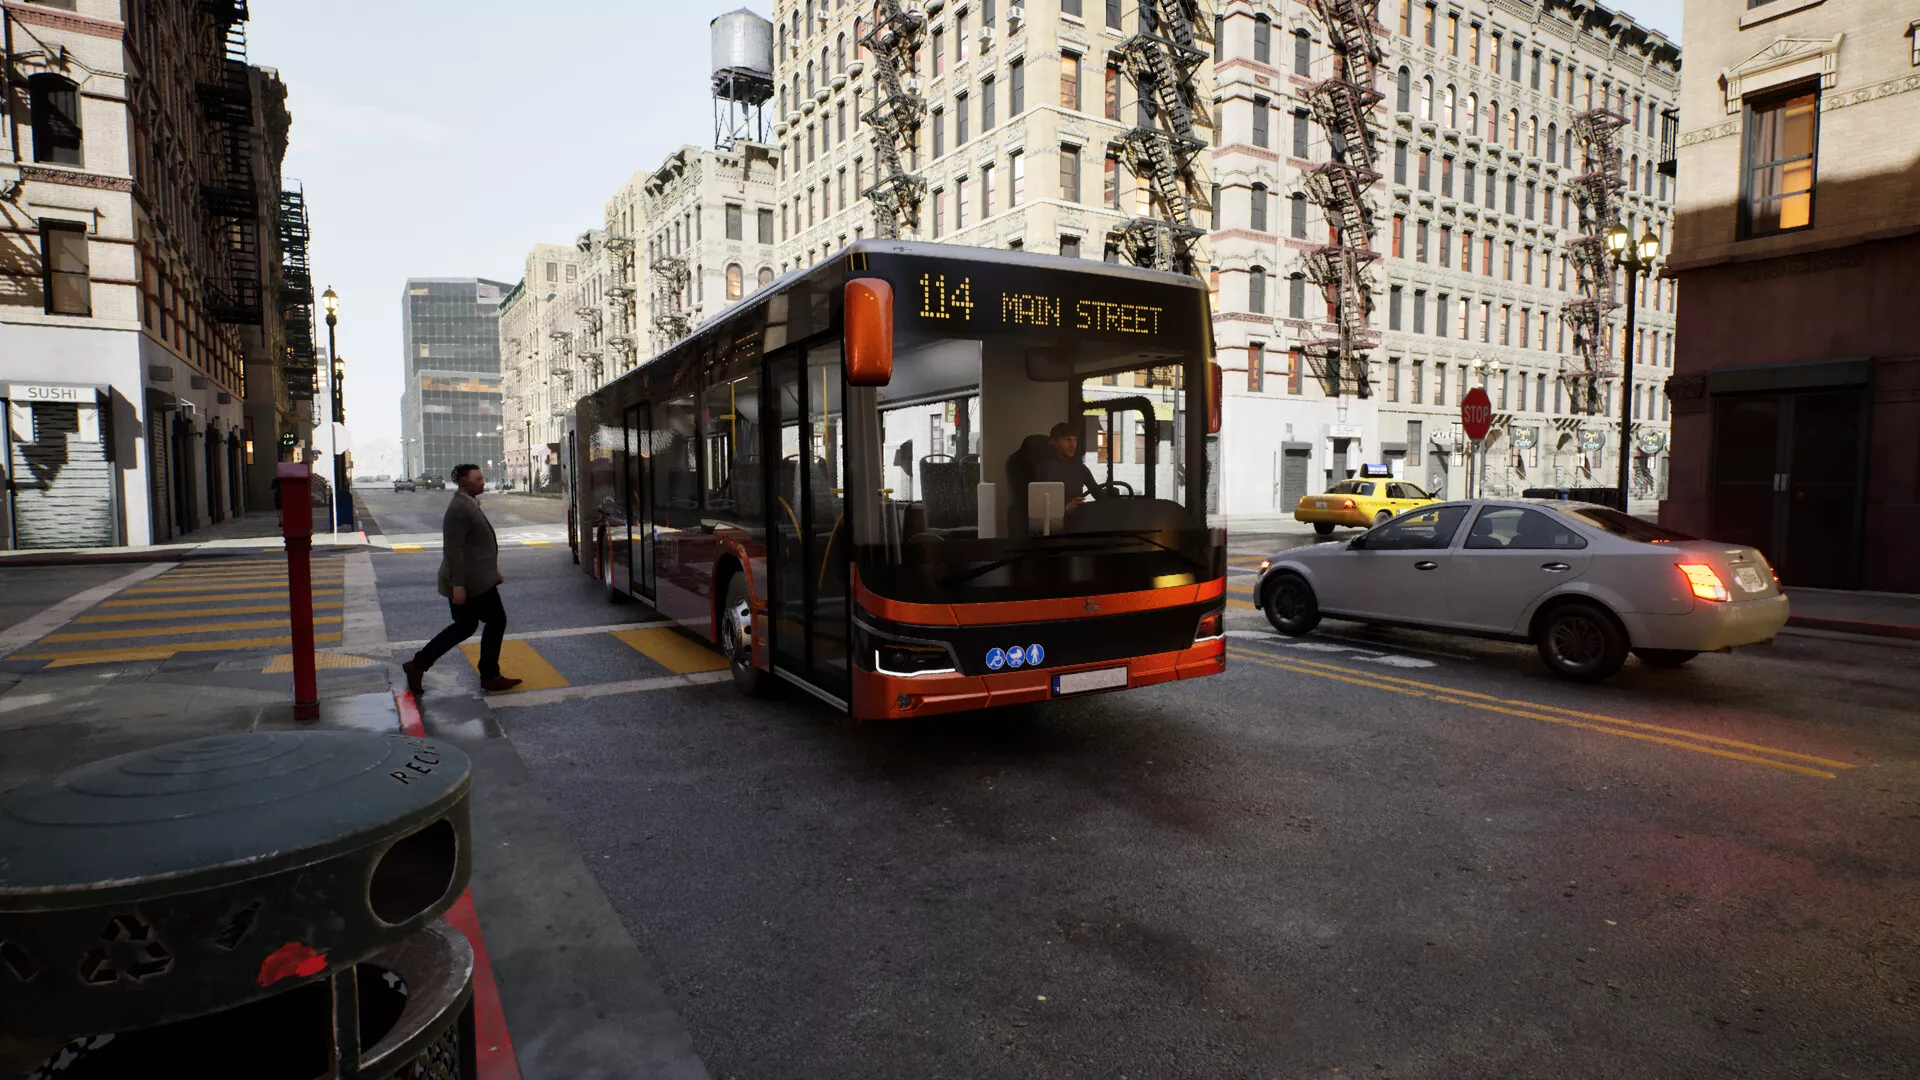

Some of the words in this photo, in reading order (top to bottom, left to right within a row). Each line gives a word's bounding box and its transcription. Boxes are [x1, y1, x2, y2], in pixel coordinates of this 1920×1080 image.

[919, 273, 974, 321] 114
[1002, 292, 1060, 327] MAIN
[1076, 300, 1163, 335] STREET
[28, 387, 77, 399] SUSHI
[1464, 405, 1490, 424] STOP
